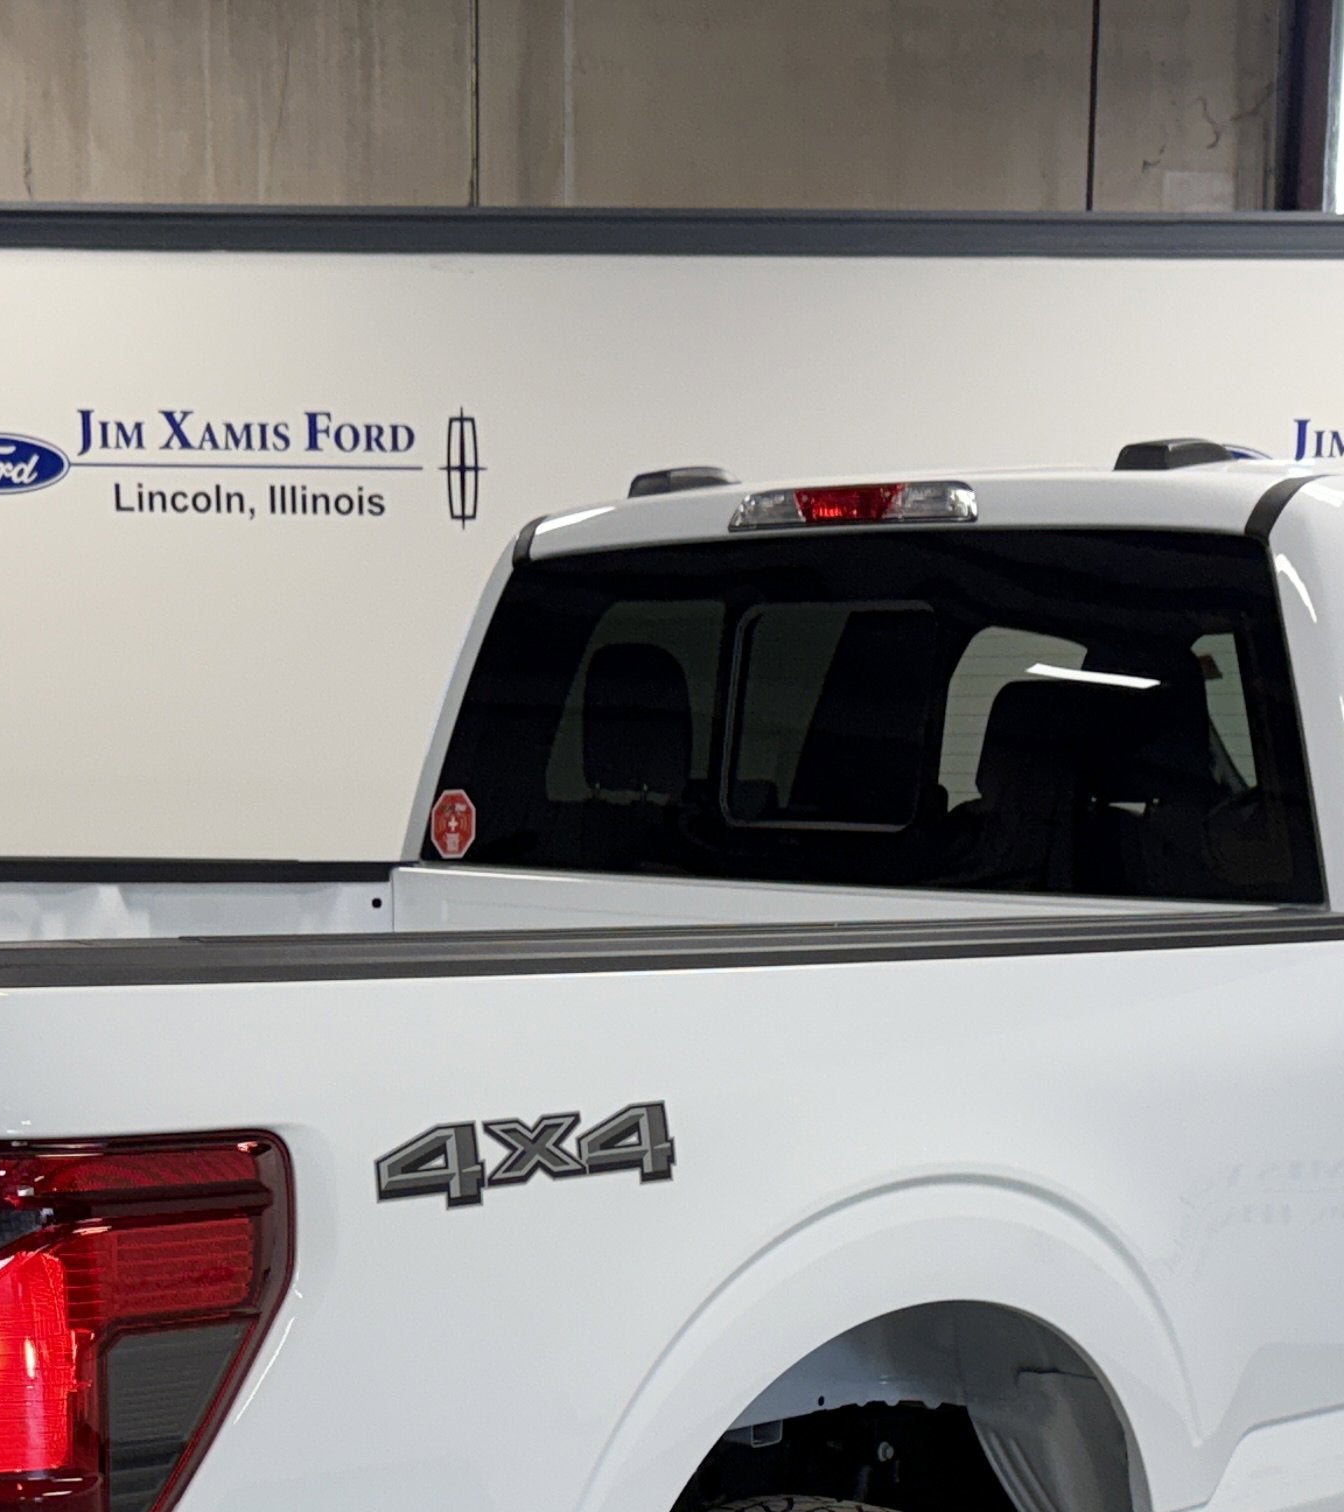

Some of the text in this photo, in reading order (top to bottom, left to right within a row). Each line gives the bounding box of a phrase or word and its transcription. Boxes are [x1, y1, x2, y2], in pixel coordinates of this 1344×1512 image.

[76, 409, 416, 456] JIM XAMIS FORD
[114, 482, 386, 518] Lincoln, Illinois
